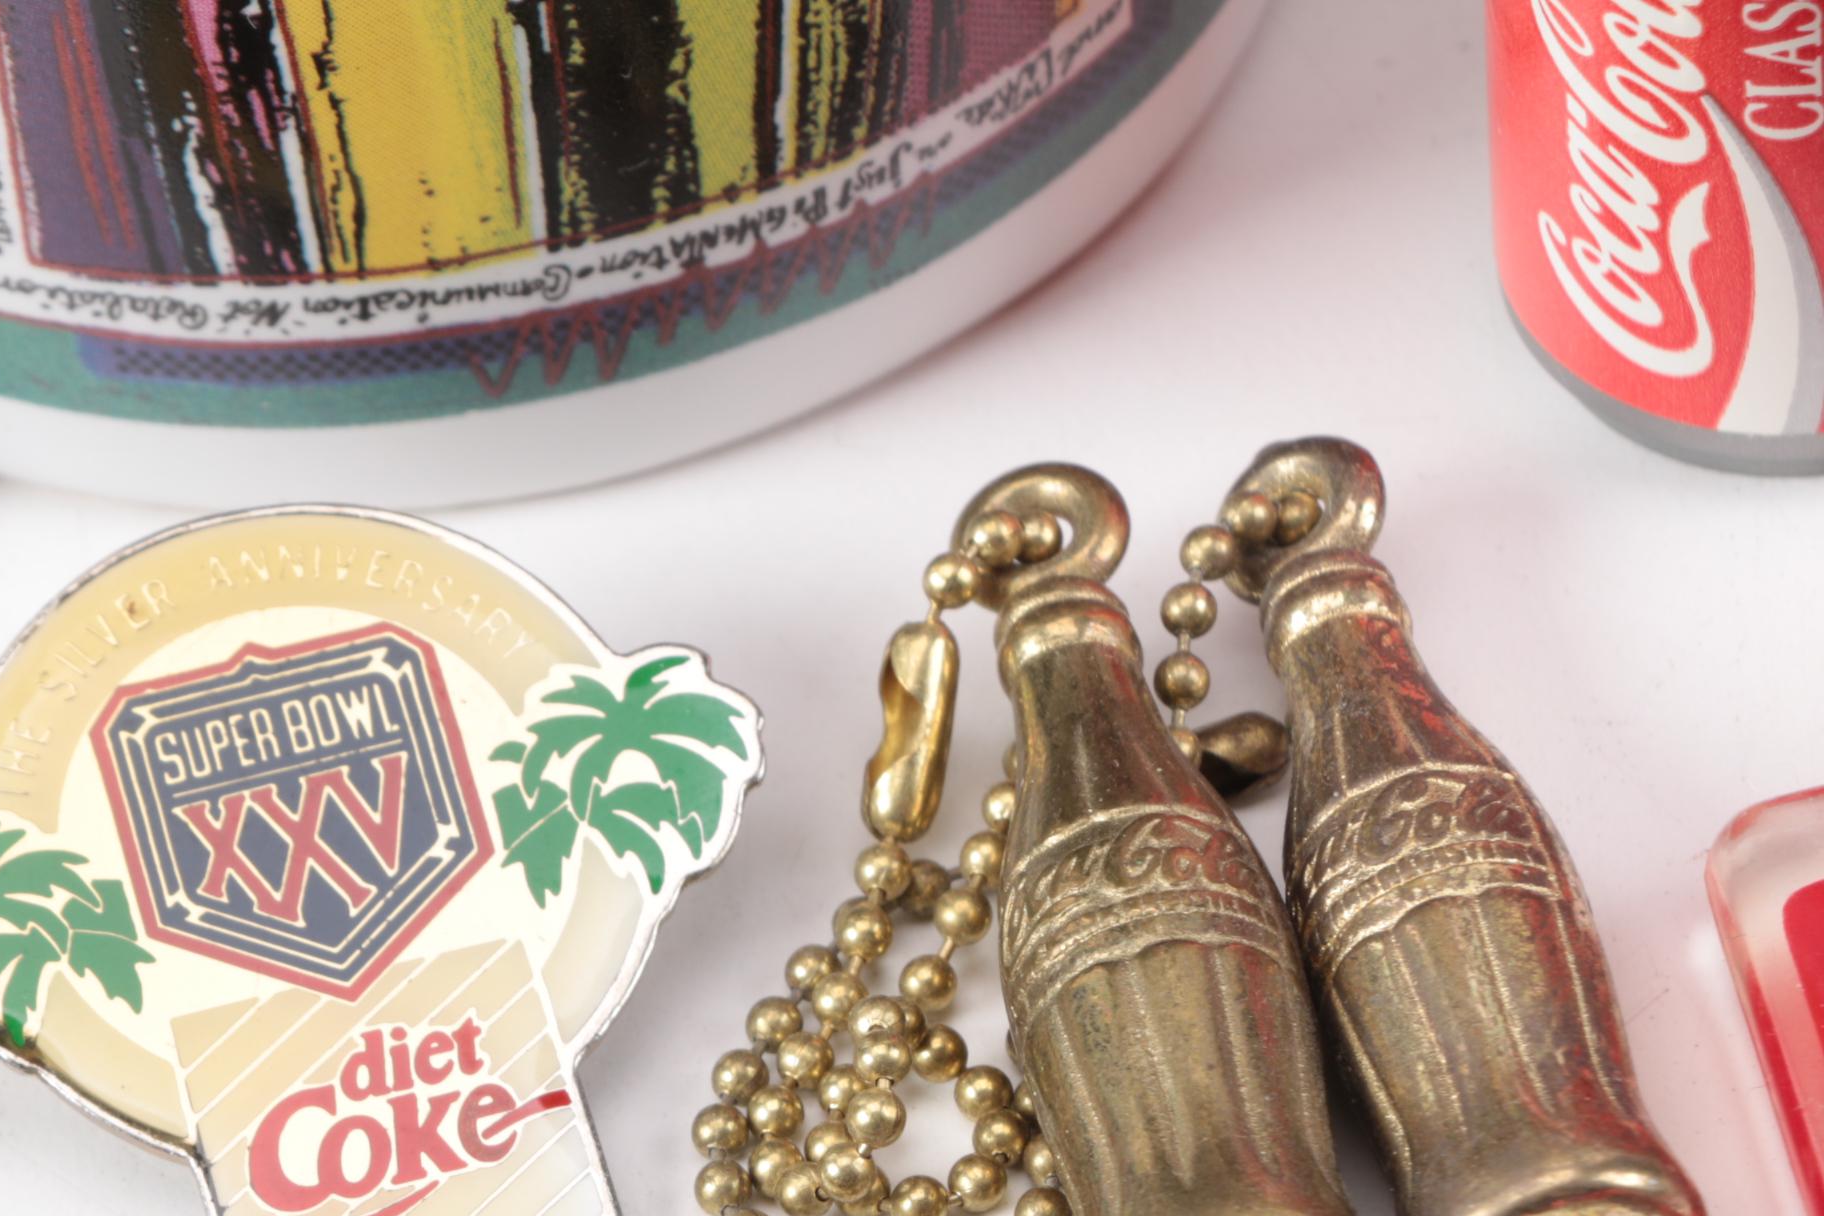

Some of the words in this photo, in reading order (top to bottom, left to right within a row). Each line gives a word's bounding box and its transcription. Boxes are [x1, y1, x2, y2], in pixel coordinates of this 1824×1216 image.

[1742, 0, 1824, 141] CLAS
[38, 578, 177, 702] SILVER
[207, 543, 535, 661] ANNIVERSARY
[155, 707, 281, 786] SUPER
[281, 683, 400, 754] BOWL
[171, 750, 409, 929] XXV
[340, 1017, 484, 1101] diet
